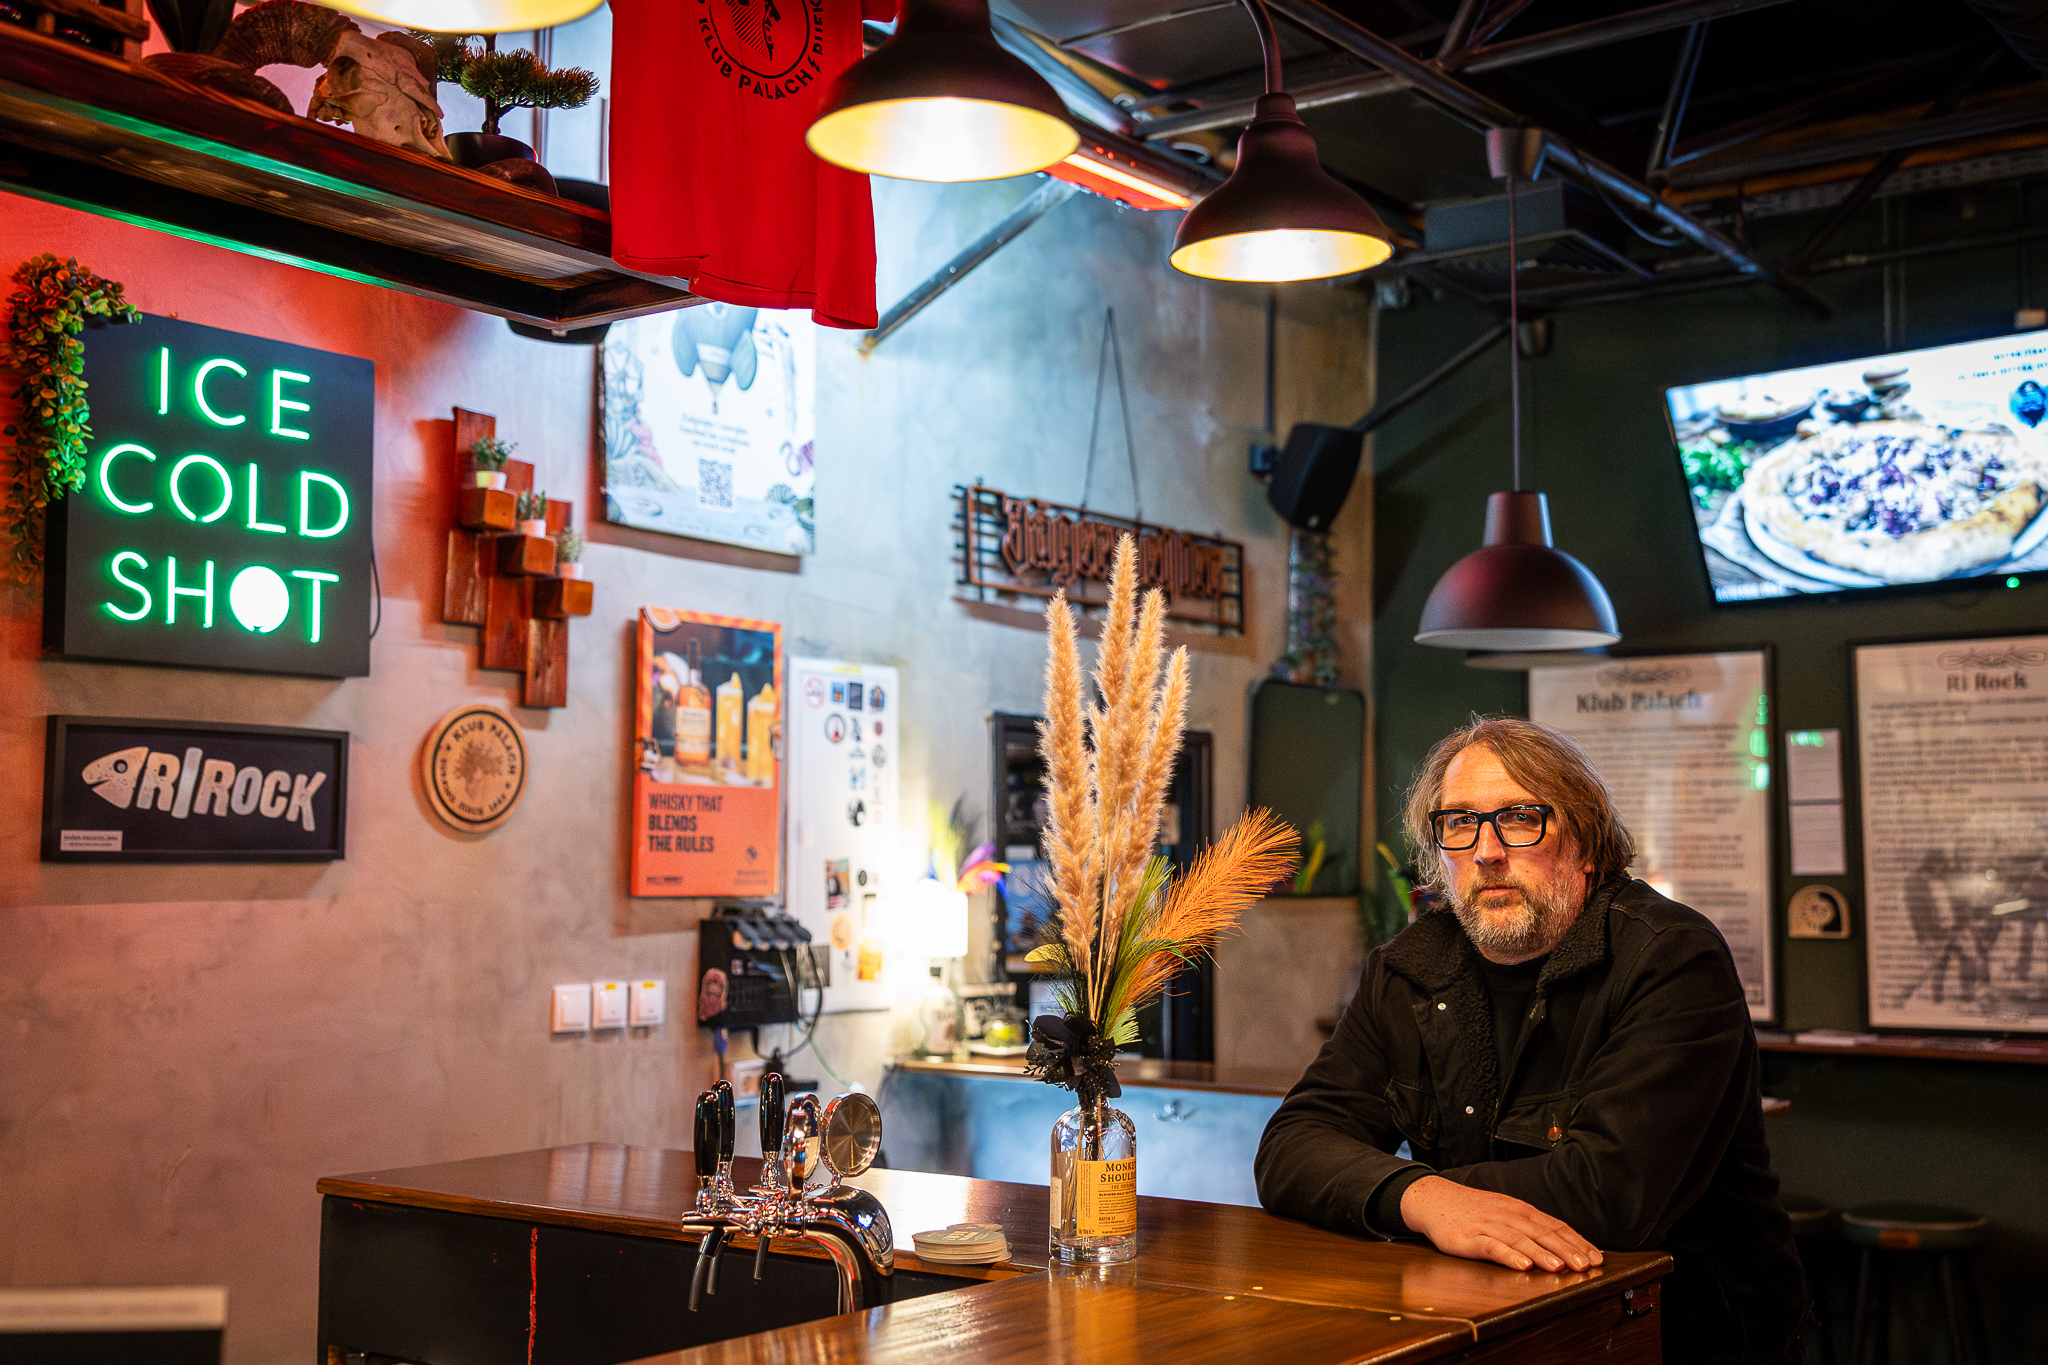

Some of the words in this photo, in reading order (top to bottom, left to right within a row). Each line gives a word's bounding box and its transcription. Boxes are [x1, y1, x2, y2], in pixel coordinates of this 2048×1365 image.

[699, 18, 733, 78] KLUB
[739, 69, 814, 100] PALACH
[159, 346, 311, 440] ICE
[100, 443, 349, 538] COLD
[106, 551, 340, 643] SHOT
[1975, 671, 2029, 691] Rock
[1577, 691, 1626, 713] Klub
[1631, 690, 1700, 711] Palach
[648, 792, 693, 811] WHISKY
[697, 794, 723, 812] THAT
[648, 814, 698, 832] BLENDS
[649, 835, 672, 852] THE
[675, 836, 715, 853] RULES
